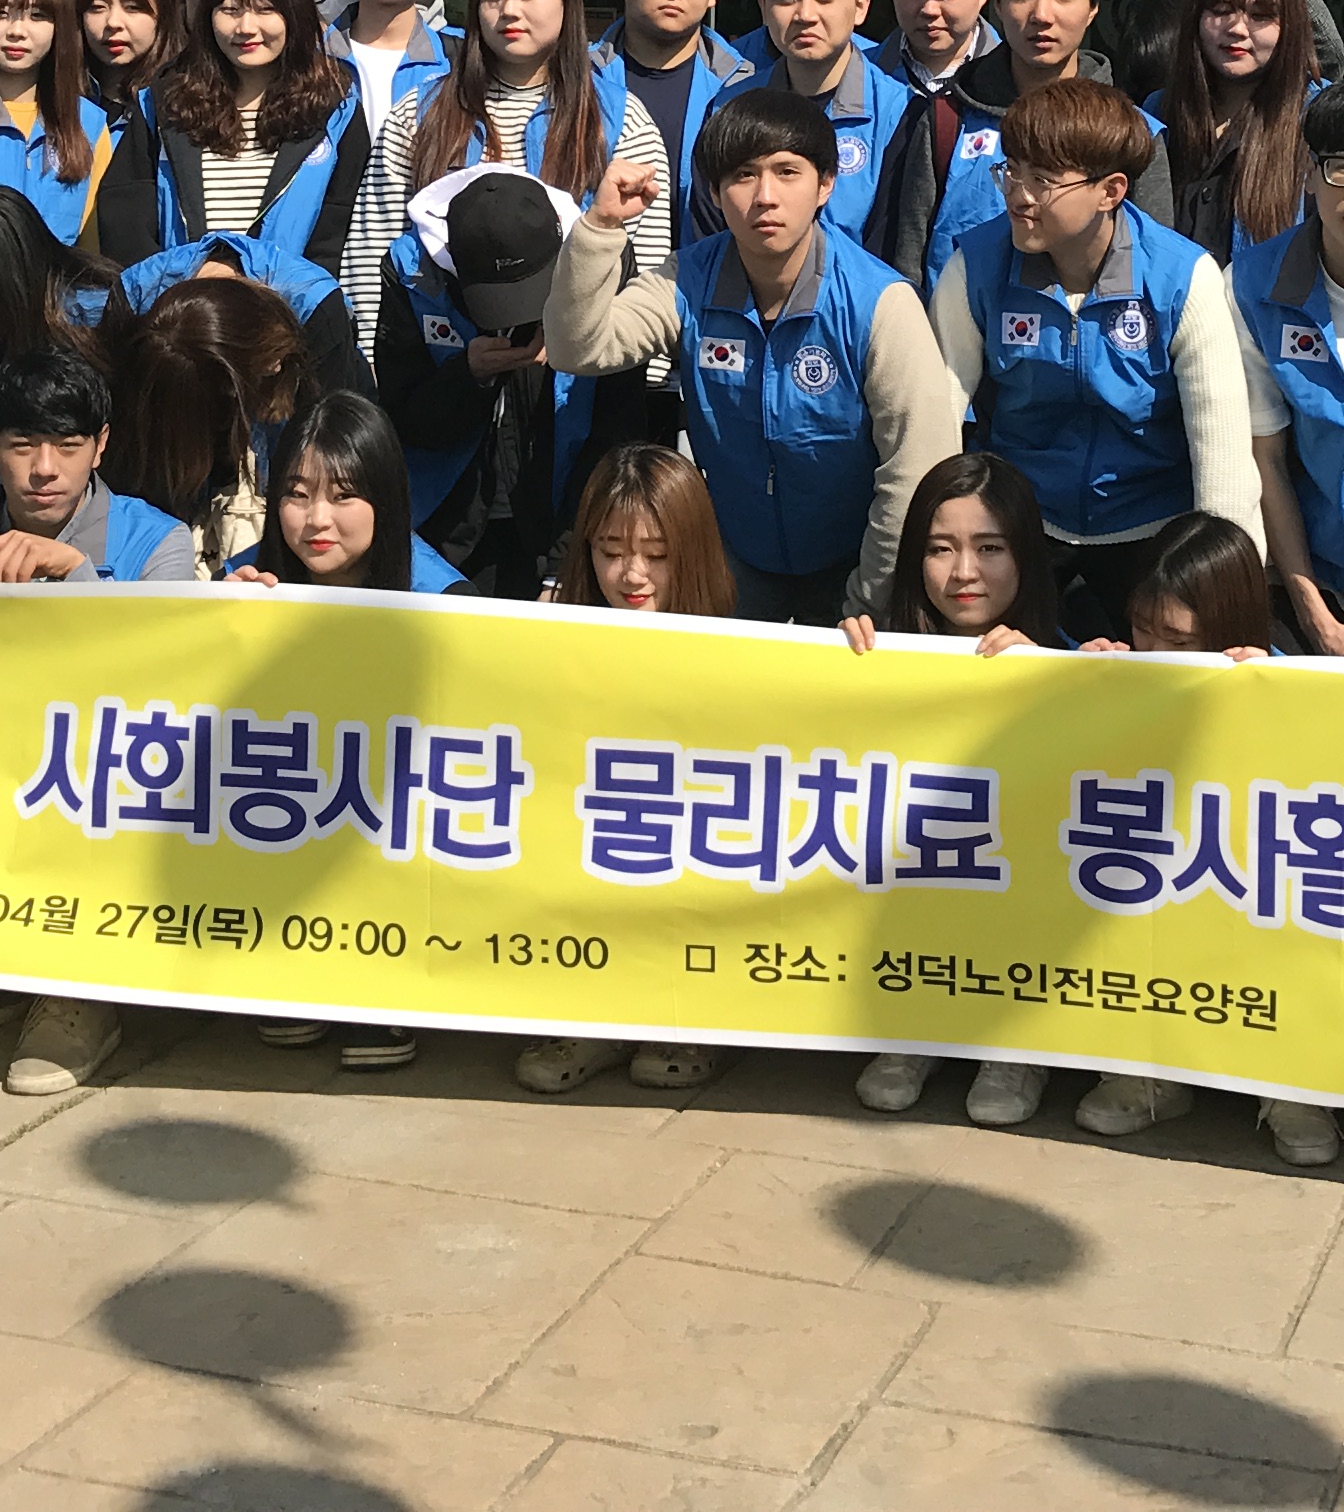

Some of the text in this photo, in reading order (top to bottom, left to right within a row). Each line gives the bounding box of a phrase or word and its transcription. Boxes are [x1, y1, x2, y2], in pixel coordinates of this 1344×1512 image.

[23, 706, 525, 859] 사회봉사단
[583, 749, 1006, 885] 물리치료
[95, 901, 265, 953] 27일(목)
[281, 914, 407, 958] 09:00
[485, 933, 610, 971] 13:00
[742, 942, 848, 985] 장소:
[871, 949, 1278, 1032] 성덕노인전문요양원
